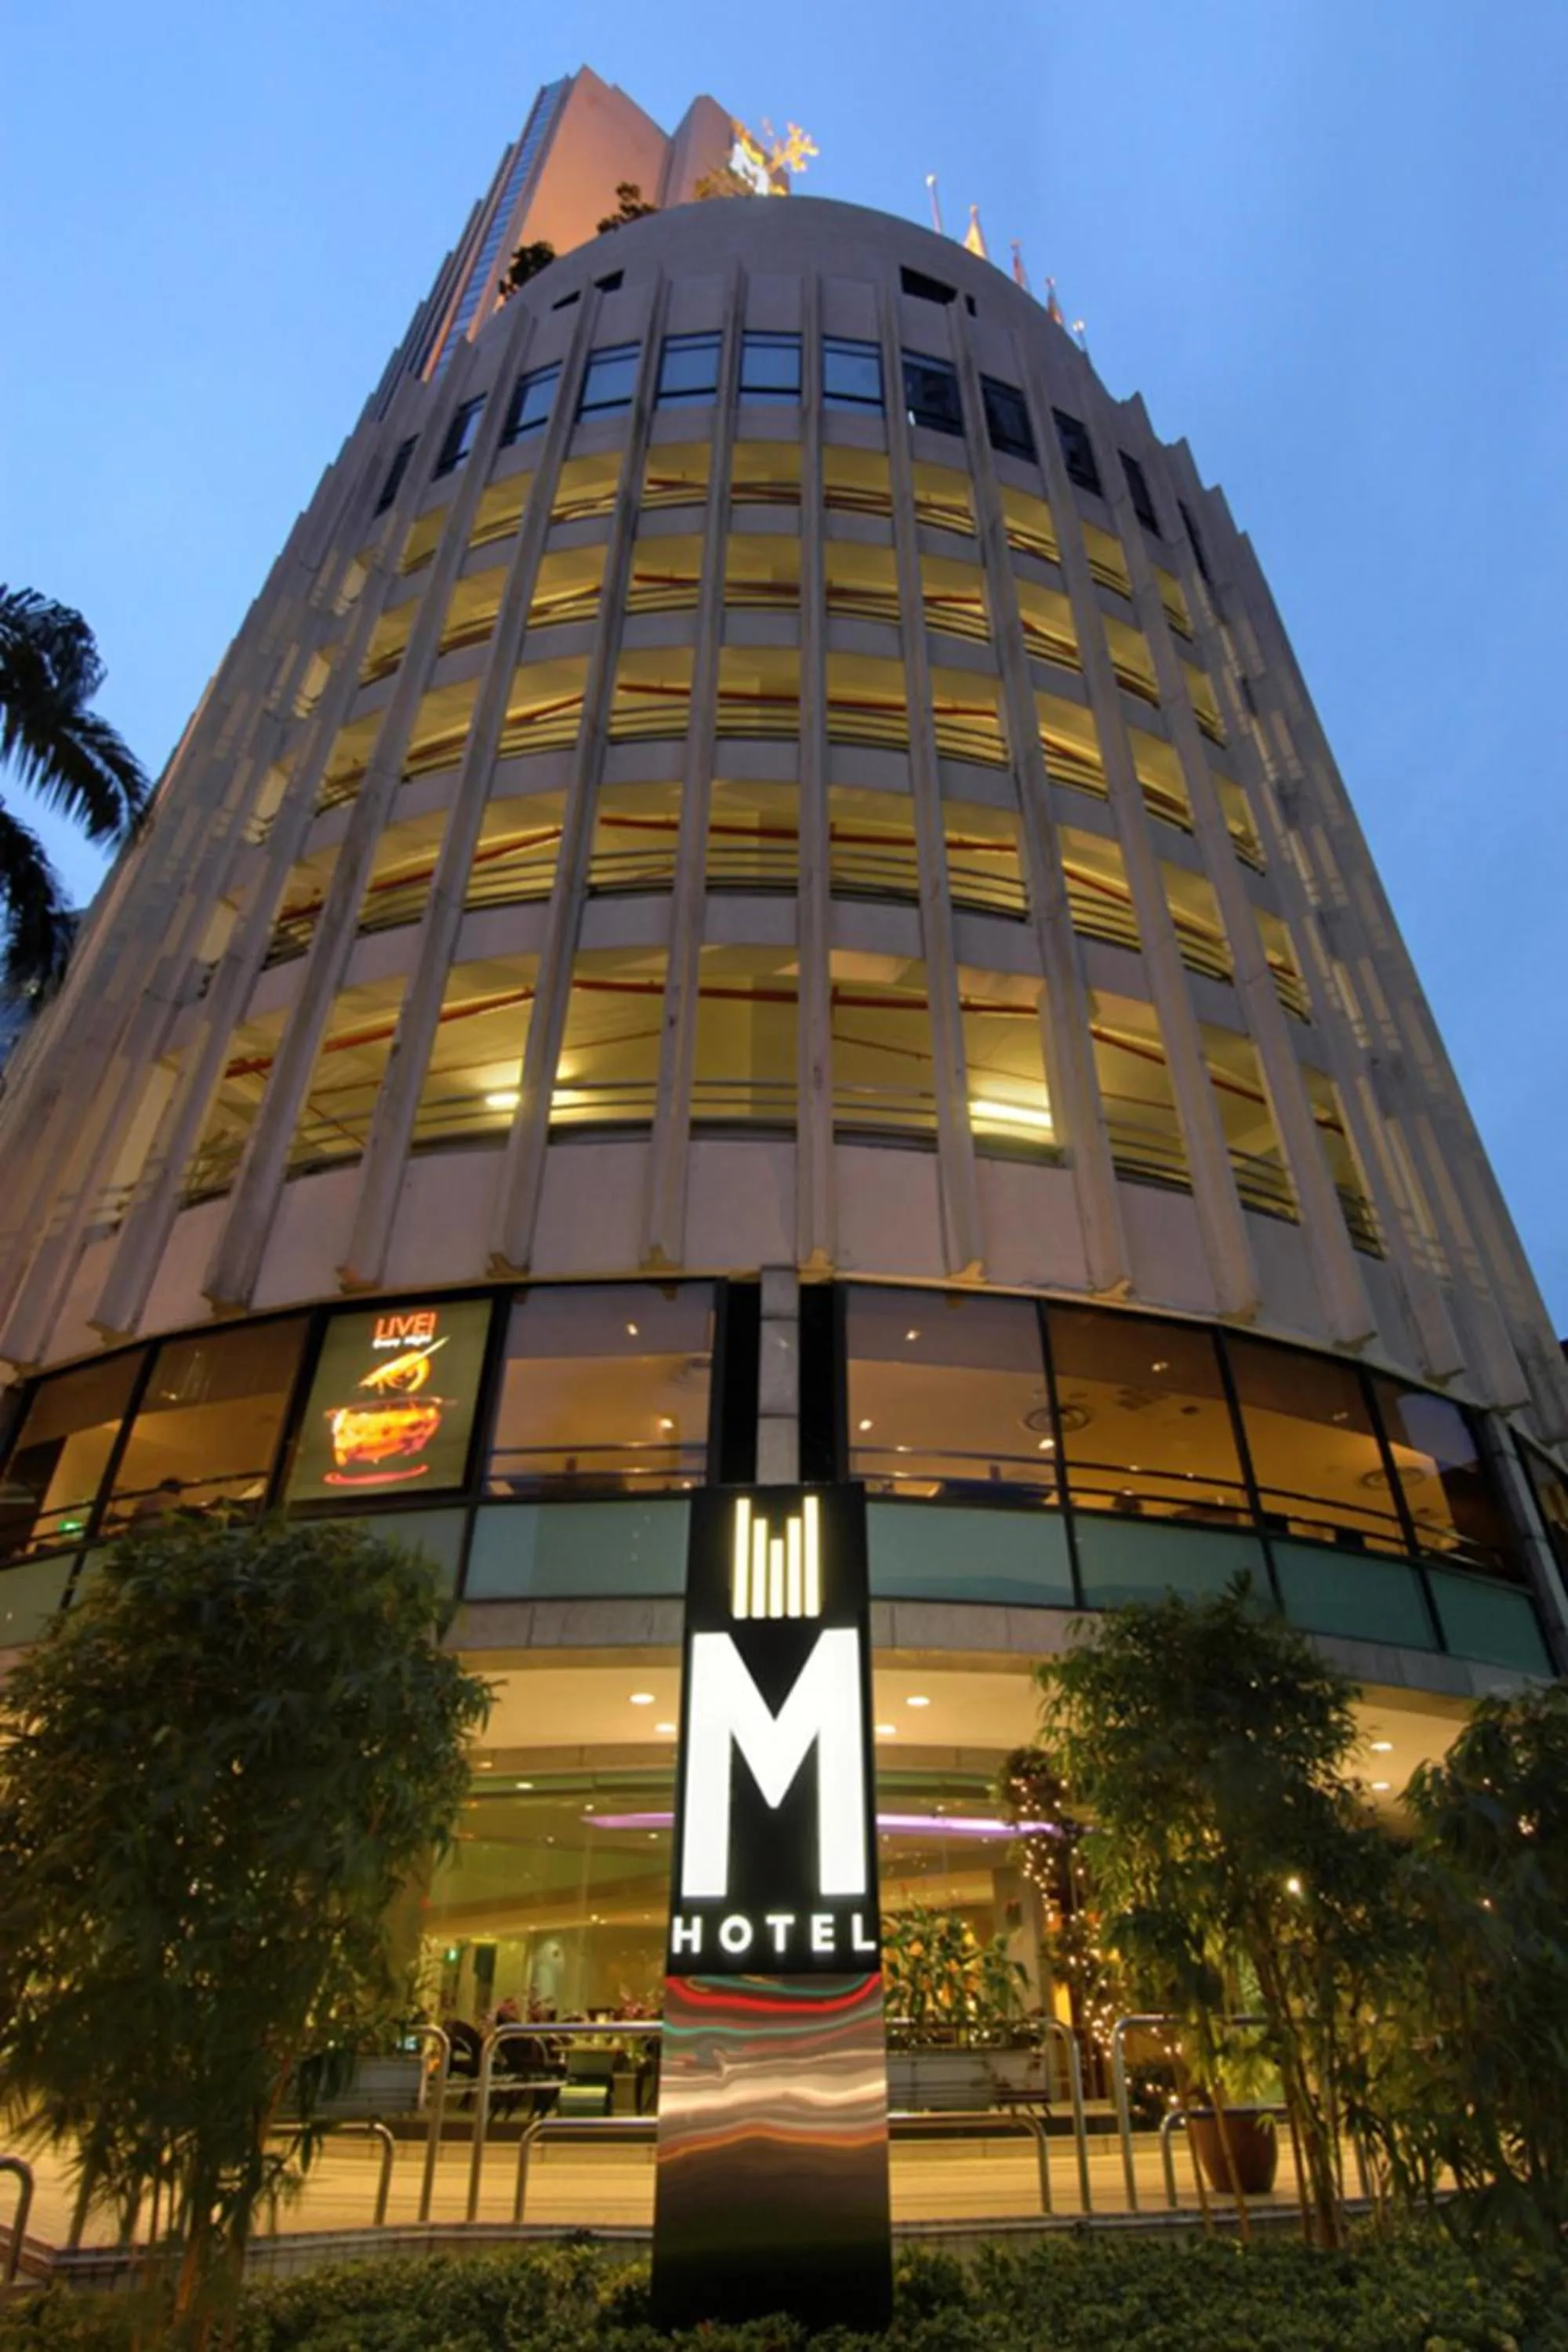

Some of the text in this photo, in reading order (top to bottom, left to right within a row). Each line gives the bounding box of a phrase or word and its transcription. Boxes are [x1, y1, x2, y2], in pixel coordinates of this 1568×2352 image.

[375, 1312, 436, 1338] LIVE!
[681, 1628, 866, 1896] M
[671, 1914, 876, 1953] HOTEL
